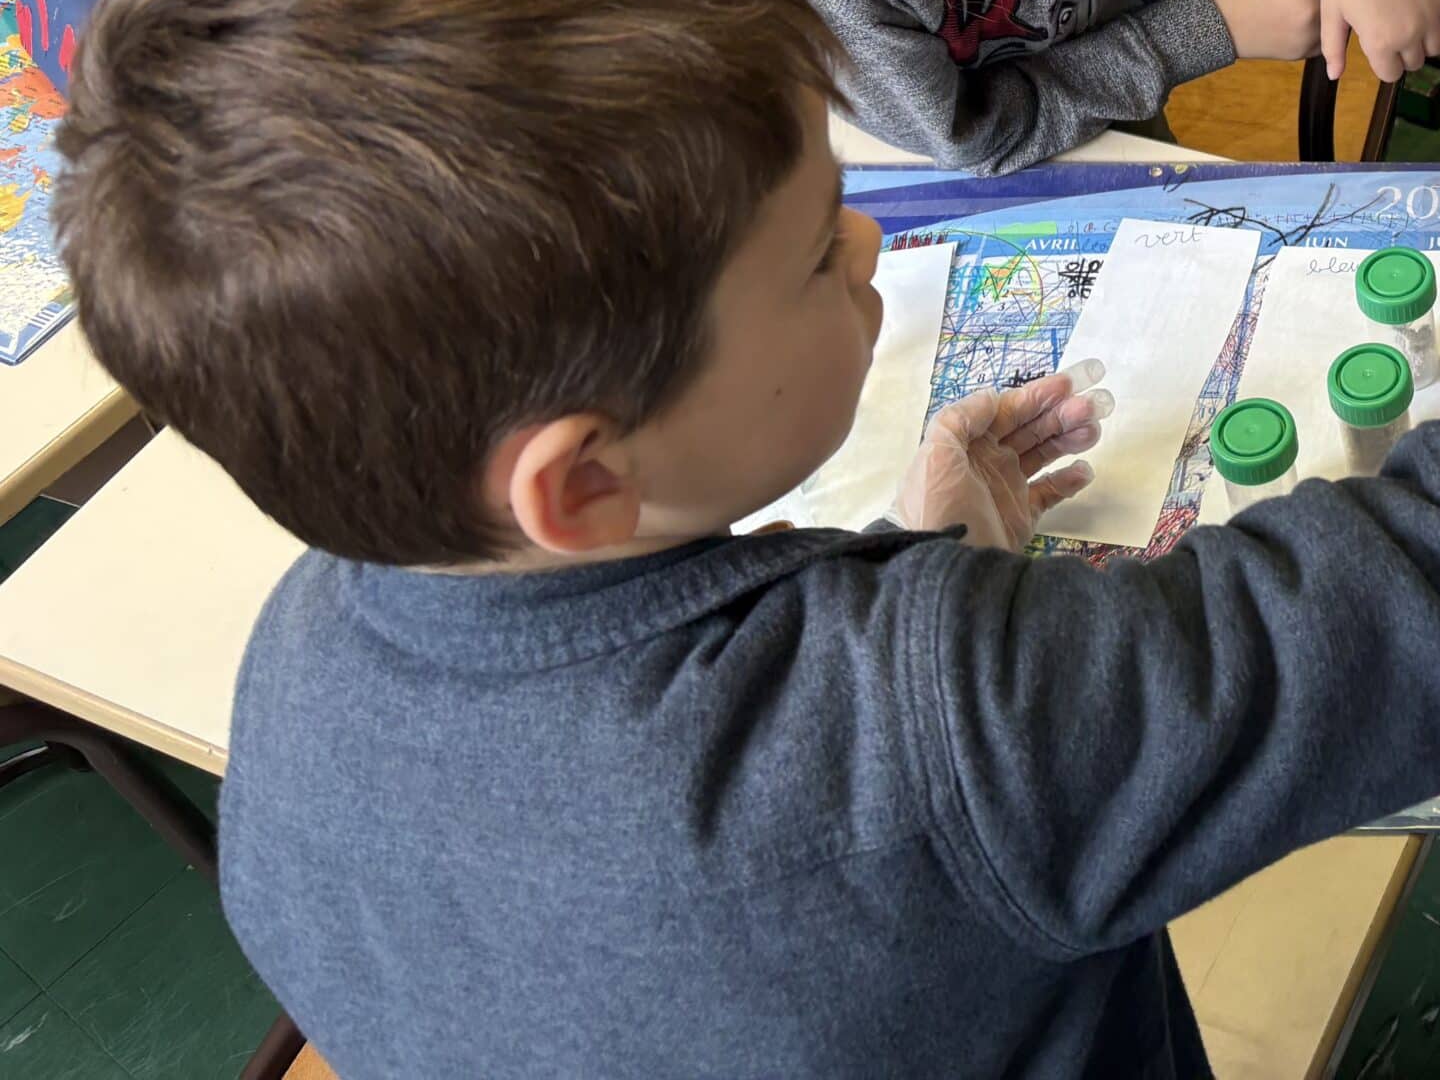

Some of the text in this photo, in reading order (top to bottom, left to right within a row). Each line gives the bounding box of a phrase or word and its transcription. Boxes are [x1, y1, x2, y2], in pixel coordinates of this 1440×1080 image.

[1134, 226, 1204, 249] vert
[1304, 236, 1349, 248] JUIN
[1025, 239, 1078, 250] AVRIL
